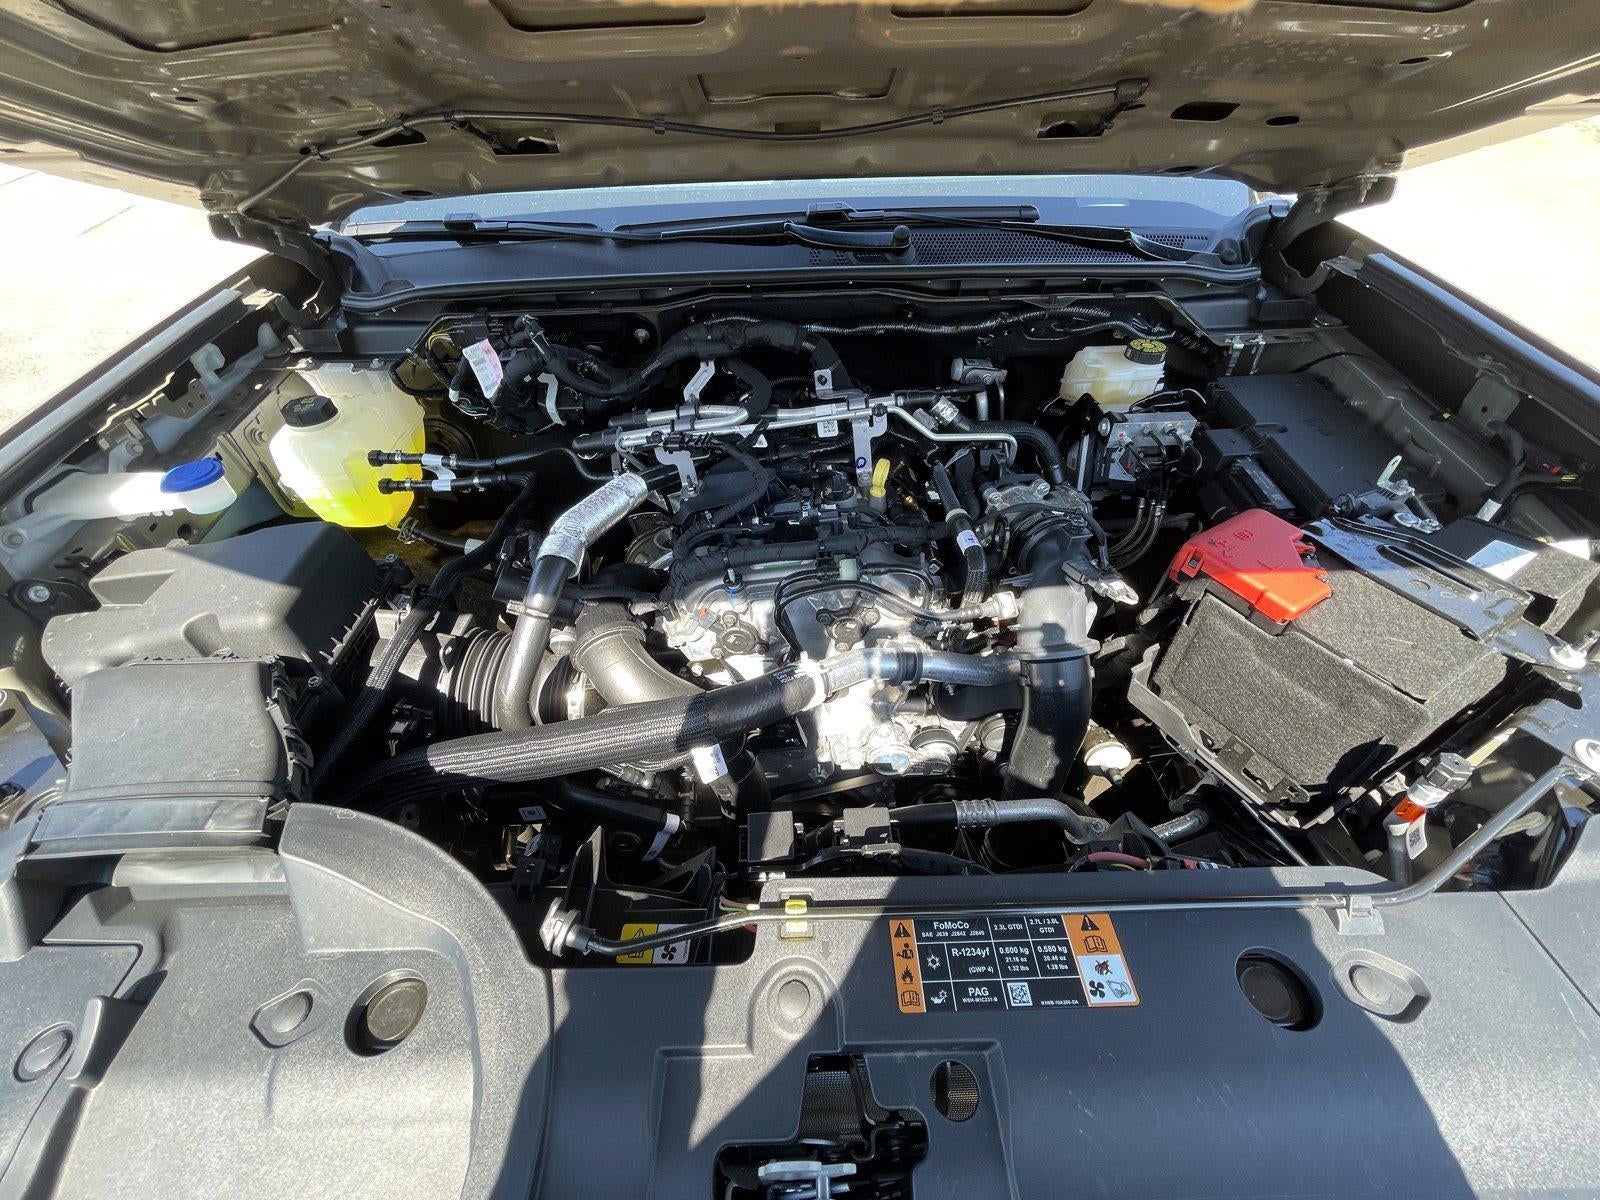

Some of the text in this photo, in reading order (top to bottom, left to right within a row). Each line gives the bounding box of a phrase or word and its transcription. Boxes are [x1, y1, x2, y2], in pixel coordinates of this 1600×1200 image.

[933, 921, 970, 930] FoMoCo
[951, 947, 990, 958] R-1234yf
[999, 946, 1029, 955] 0.600 kg
[1037, 945, 1068, 954] 0.580 kg
[968, 965, 994, 974] (GWP 4)
[968, 987, 989, 997] PAG
